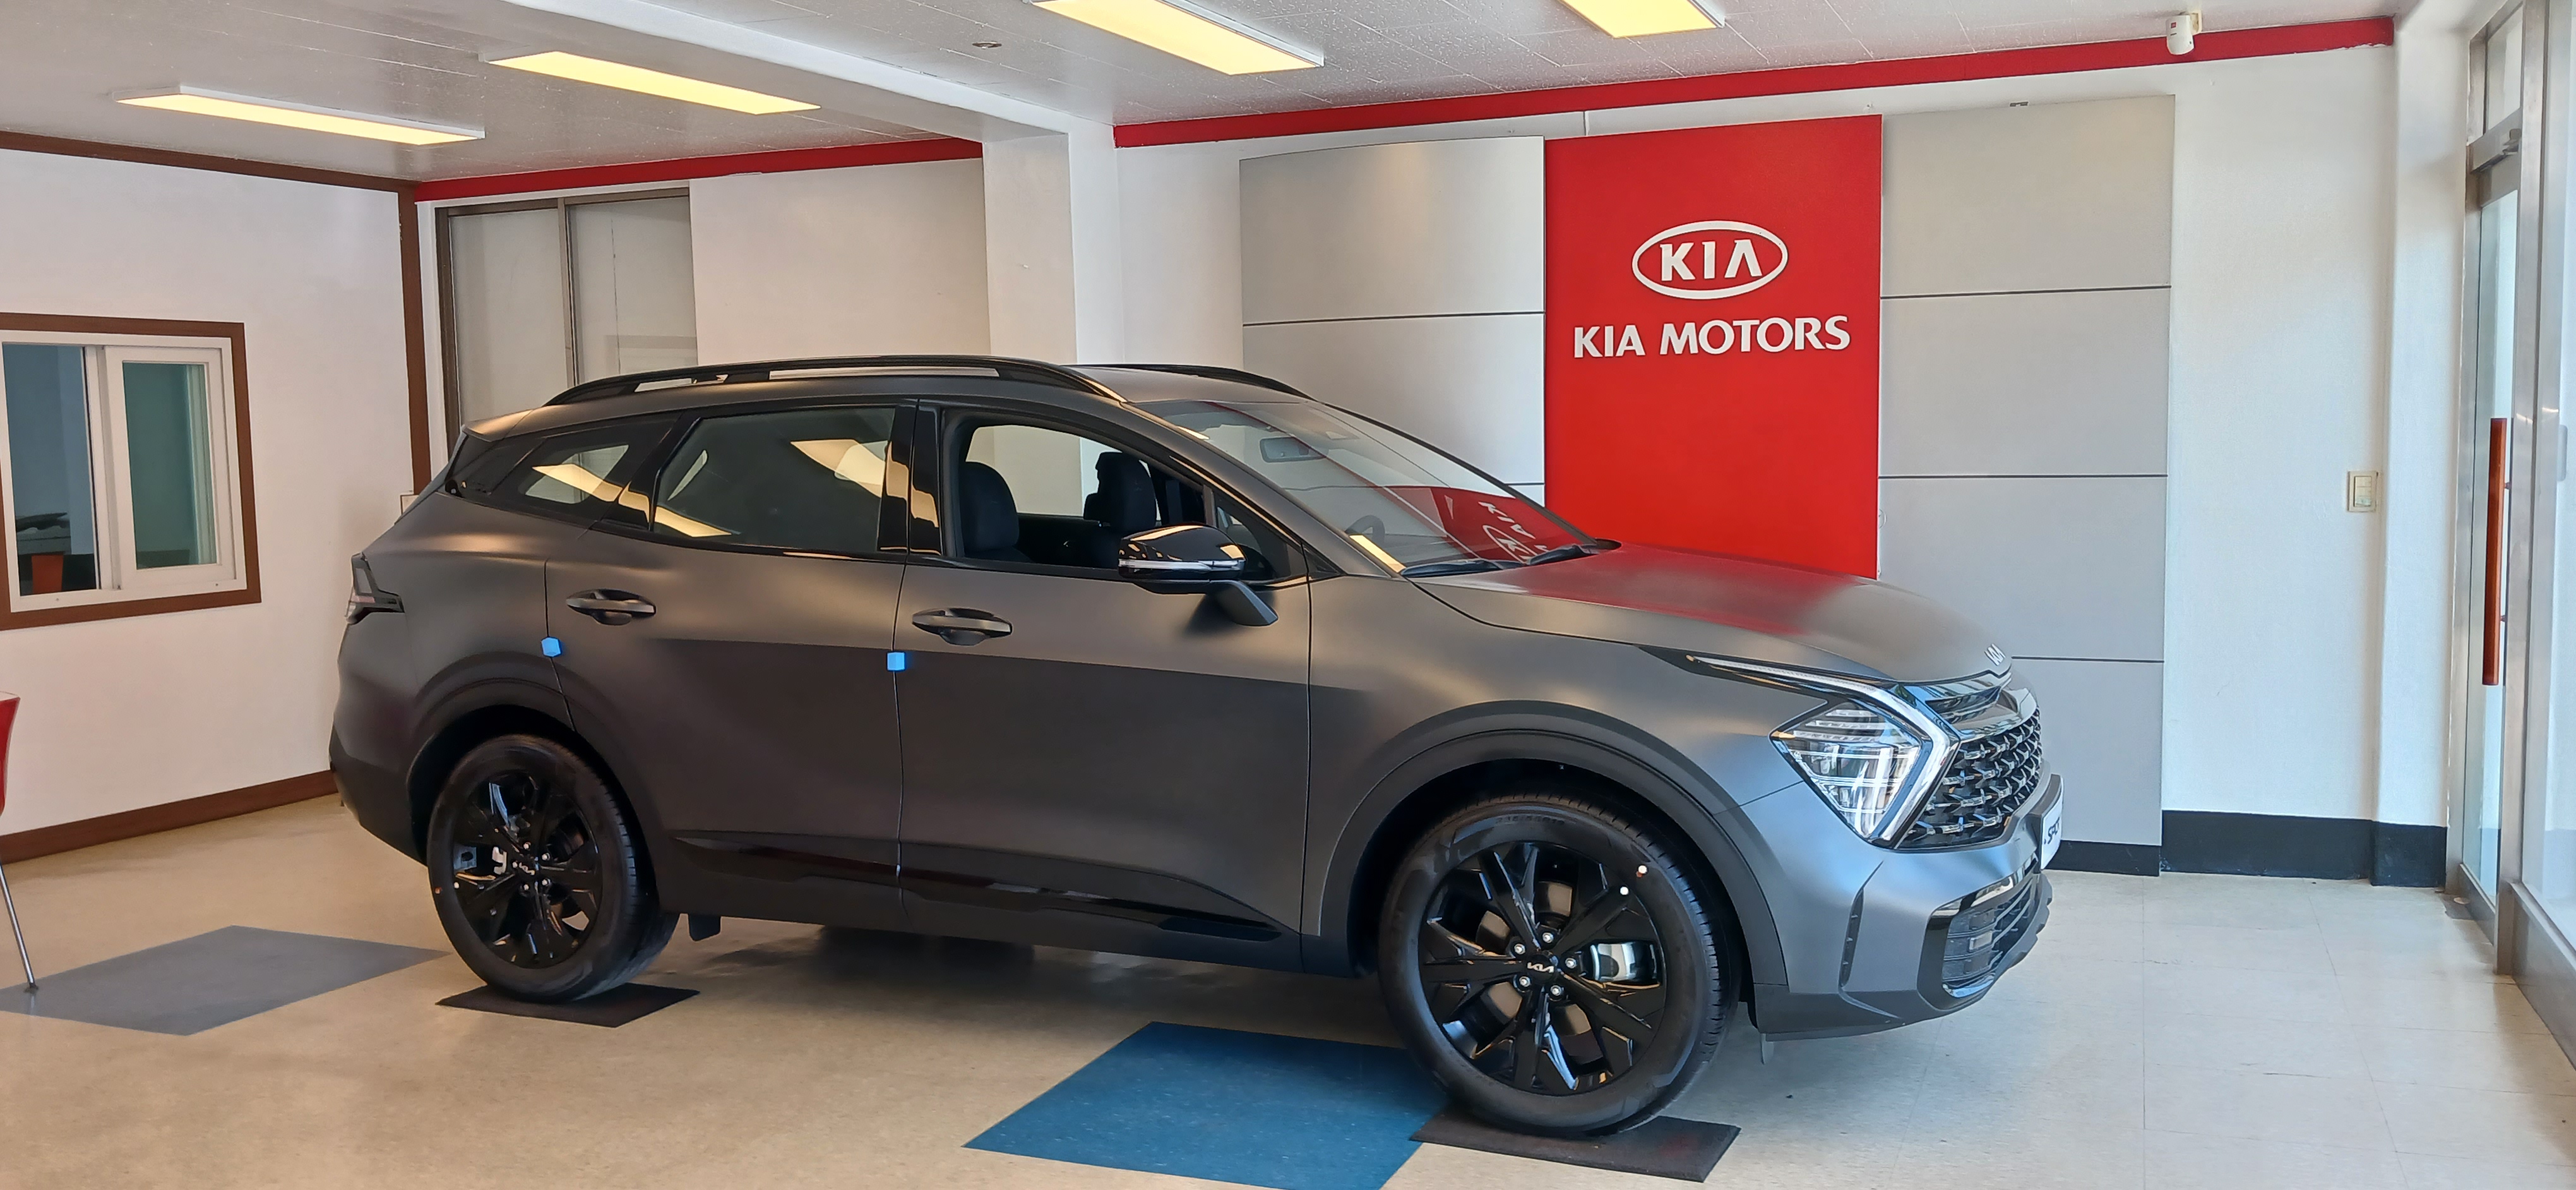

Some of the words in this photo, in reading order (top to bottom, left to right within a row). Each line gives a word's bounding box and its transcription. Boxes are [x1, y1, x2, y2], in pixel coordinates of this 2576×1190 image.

[1659, 239, 1763, 281] KIA
[1574, 325, 1646, 358] KIA
[1659, 315, 1851, 355] MOTORS
[1527, 961, 1554, 973] KIA
